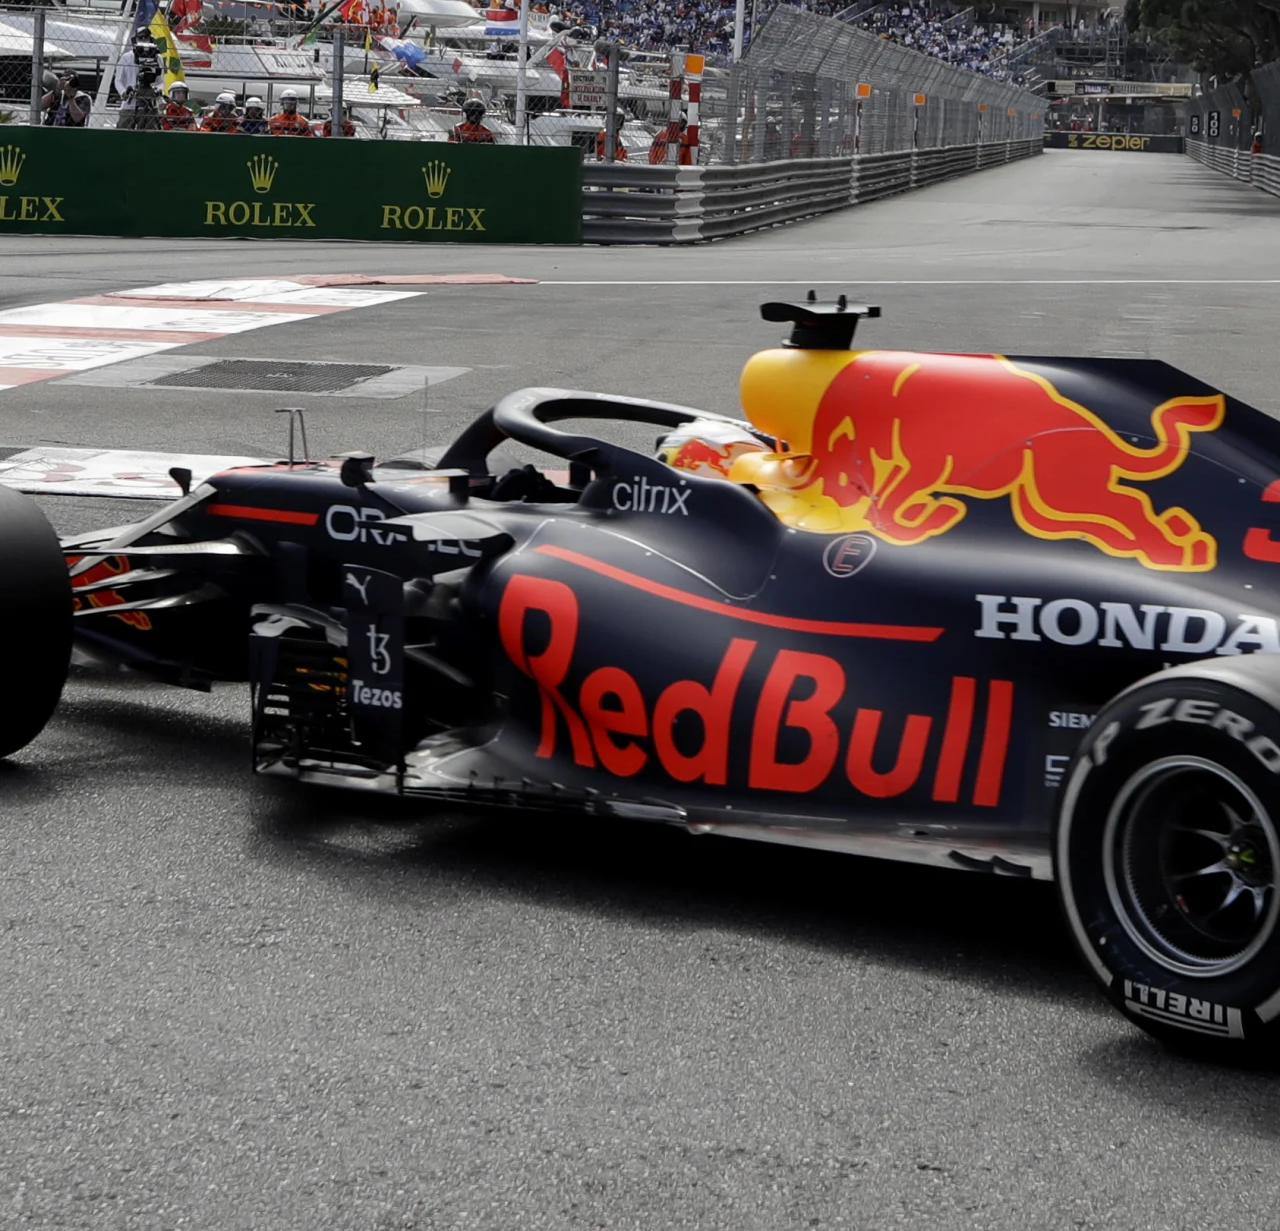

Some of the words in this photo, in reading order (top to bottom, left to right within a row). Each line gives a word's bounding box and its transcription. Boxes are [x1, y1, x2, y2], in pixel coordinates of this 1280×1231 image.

[1191, 117, 1199, 133] 50
[1209, 112, 1219, 137] 100
[1081, 134, 1151, 150] zepter
[203, 200, 317, 228] ROLEX
[380, 205, 487, 233] ROLEX
[351, 678, 403, 710] Tezos
[498, 573, 760, 786] Red
[746, 648, 1015, 807] Bull
[1091, 720, 1120, 767] P
[1123, 977, 1246, 1040] PIRELLI
